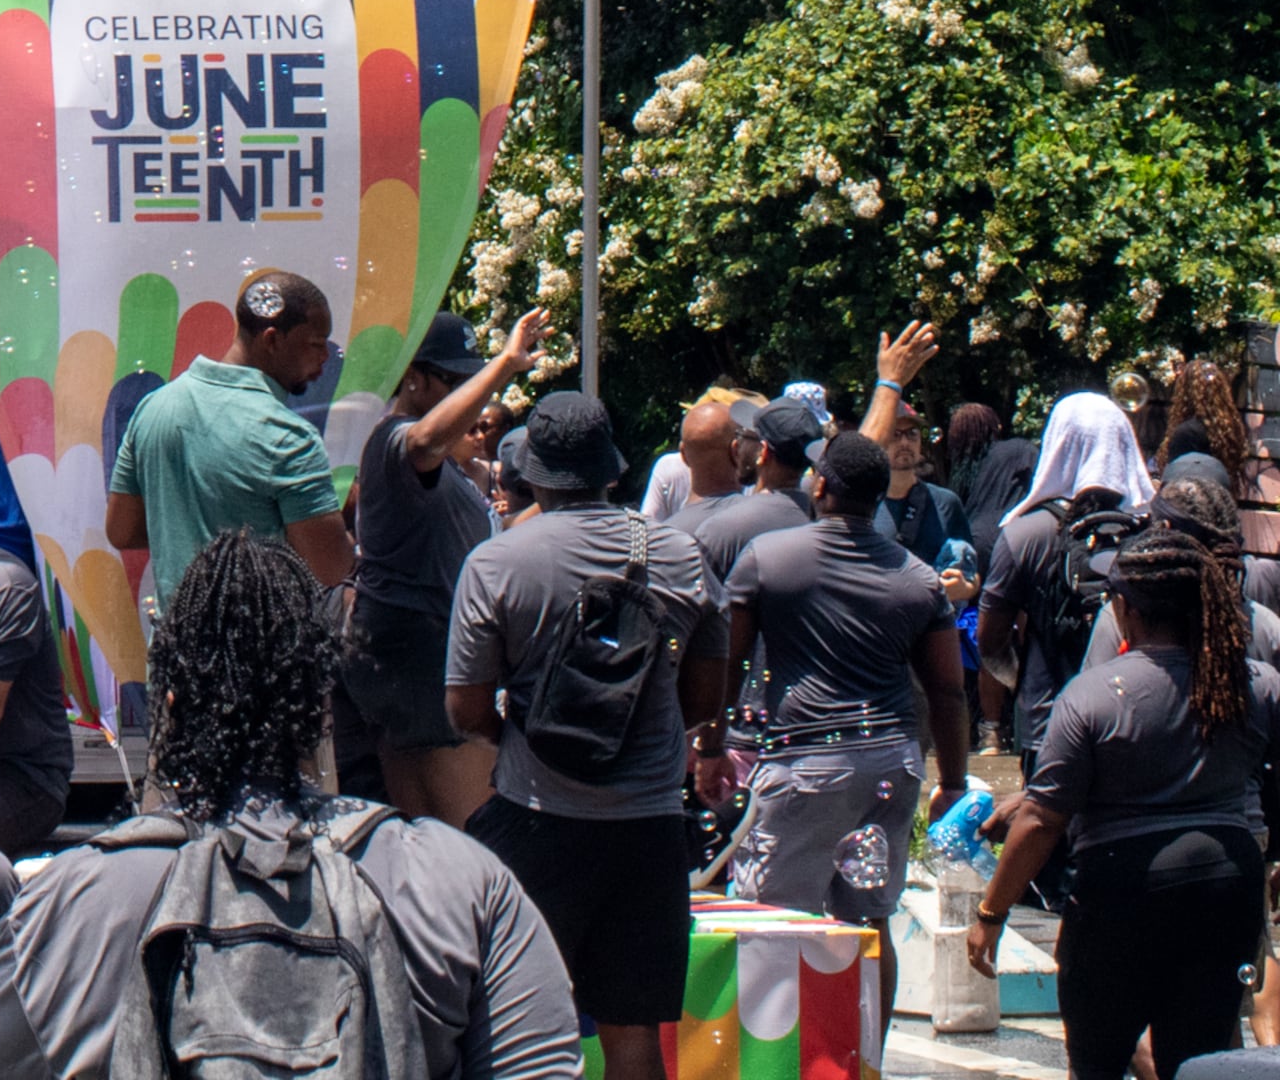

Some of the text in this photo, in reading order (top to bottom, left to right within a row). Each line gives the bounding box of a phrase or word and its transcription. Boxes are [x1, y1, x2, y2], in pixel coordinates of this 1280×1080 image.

[85, 14, 324, 41] CELEBRATING
[90, 53, 327, 158] JUNE
[92, 136, 324, 222] TEENTH
